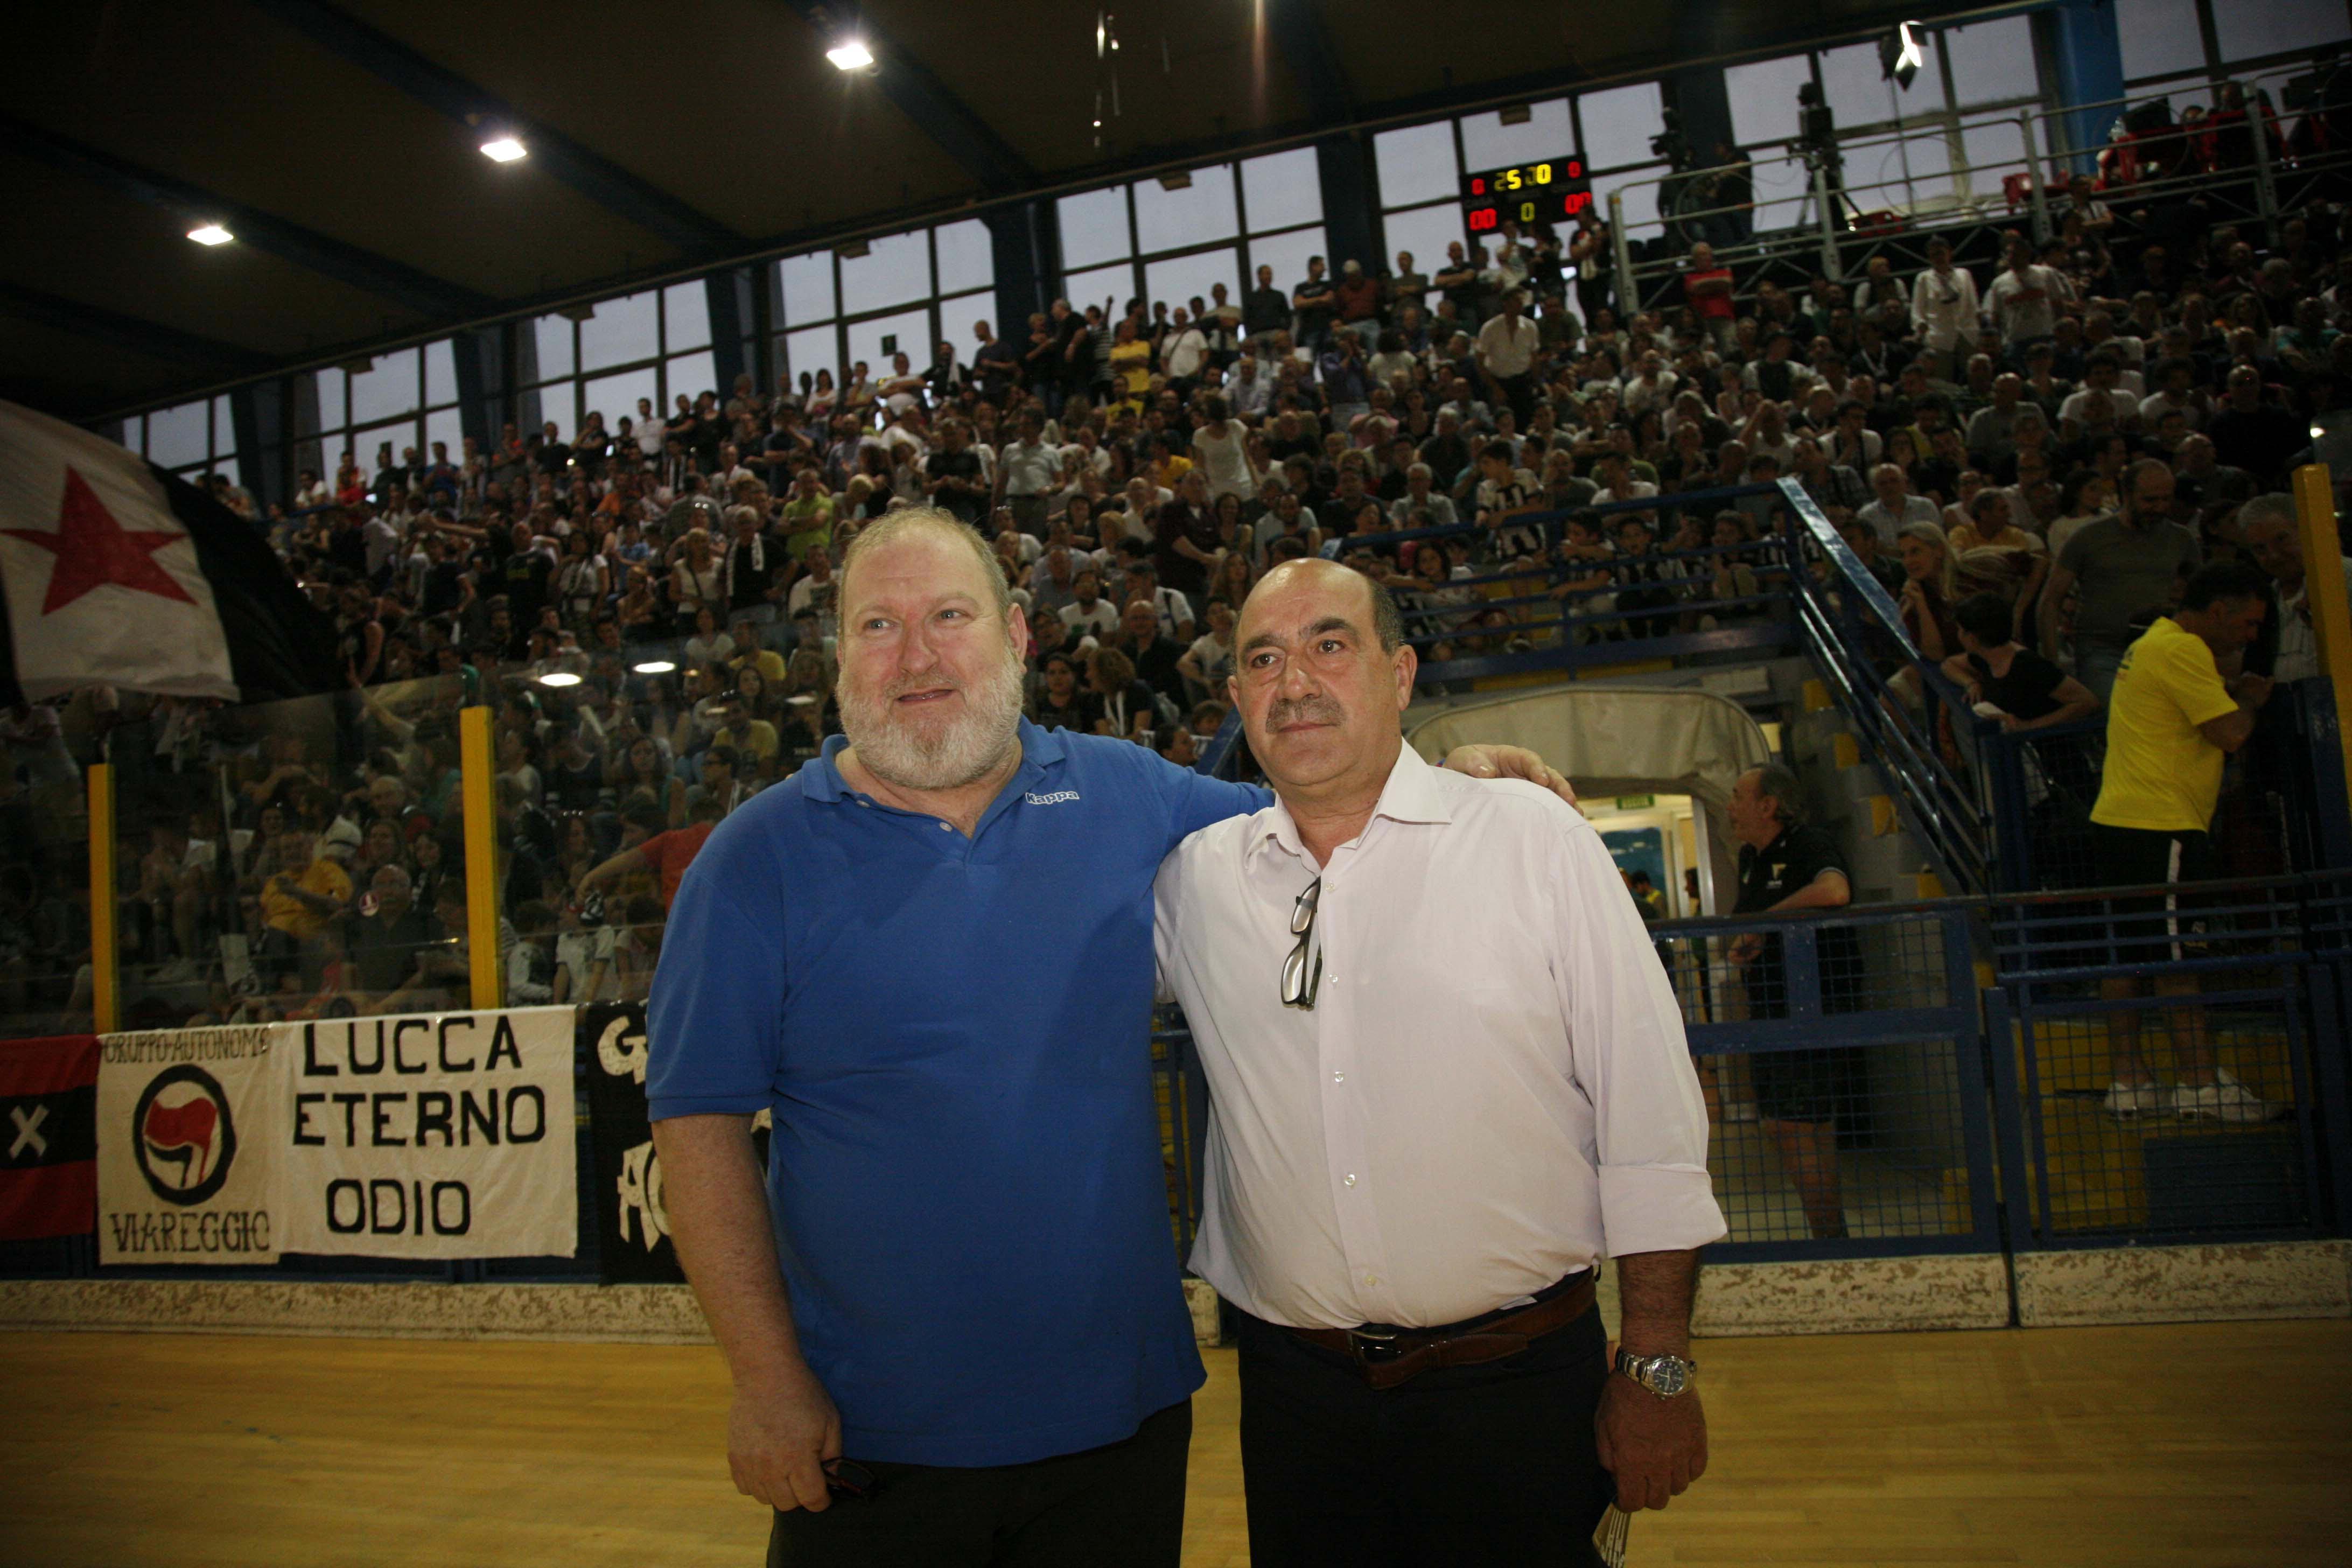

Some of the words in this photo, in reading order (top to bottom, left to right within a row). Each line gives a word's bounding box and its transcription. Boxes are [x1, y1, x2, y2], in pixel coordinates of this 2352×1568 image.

[1521, 202, 1535, 222] 0
[1025, 791, 1080, 804] Kappa
[304, 1016, 522, 1076] LUCCA
[292, 1086, 545, 1147] ETERNO
[109, 1209, 269, 1252] VIAREGGIO
[326, 1179, 471, 1236] ODIO
